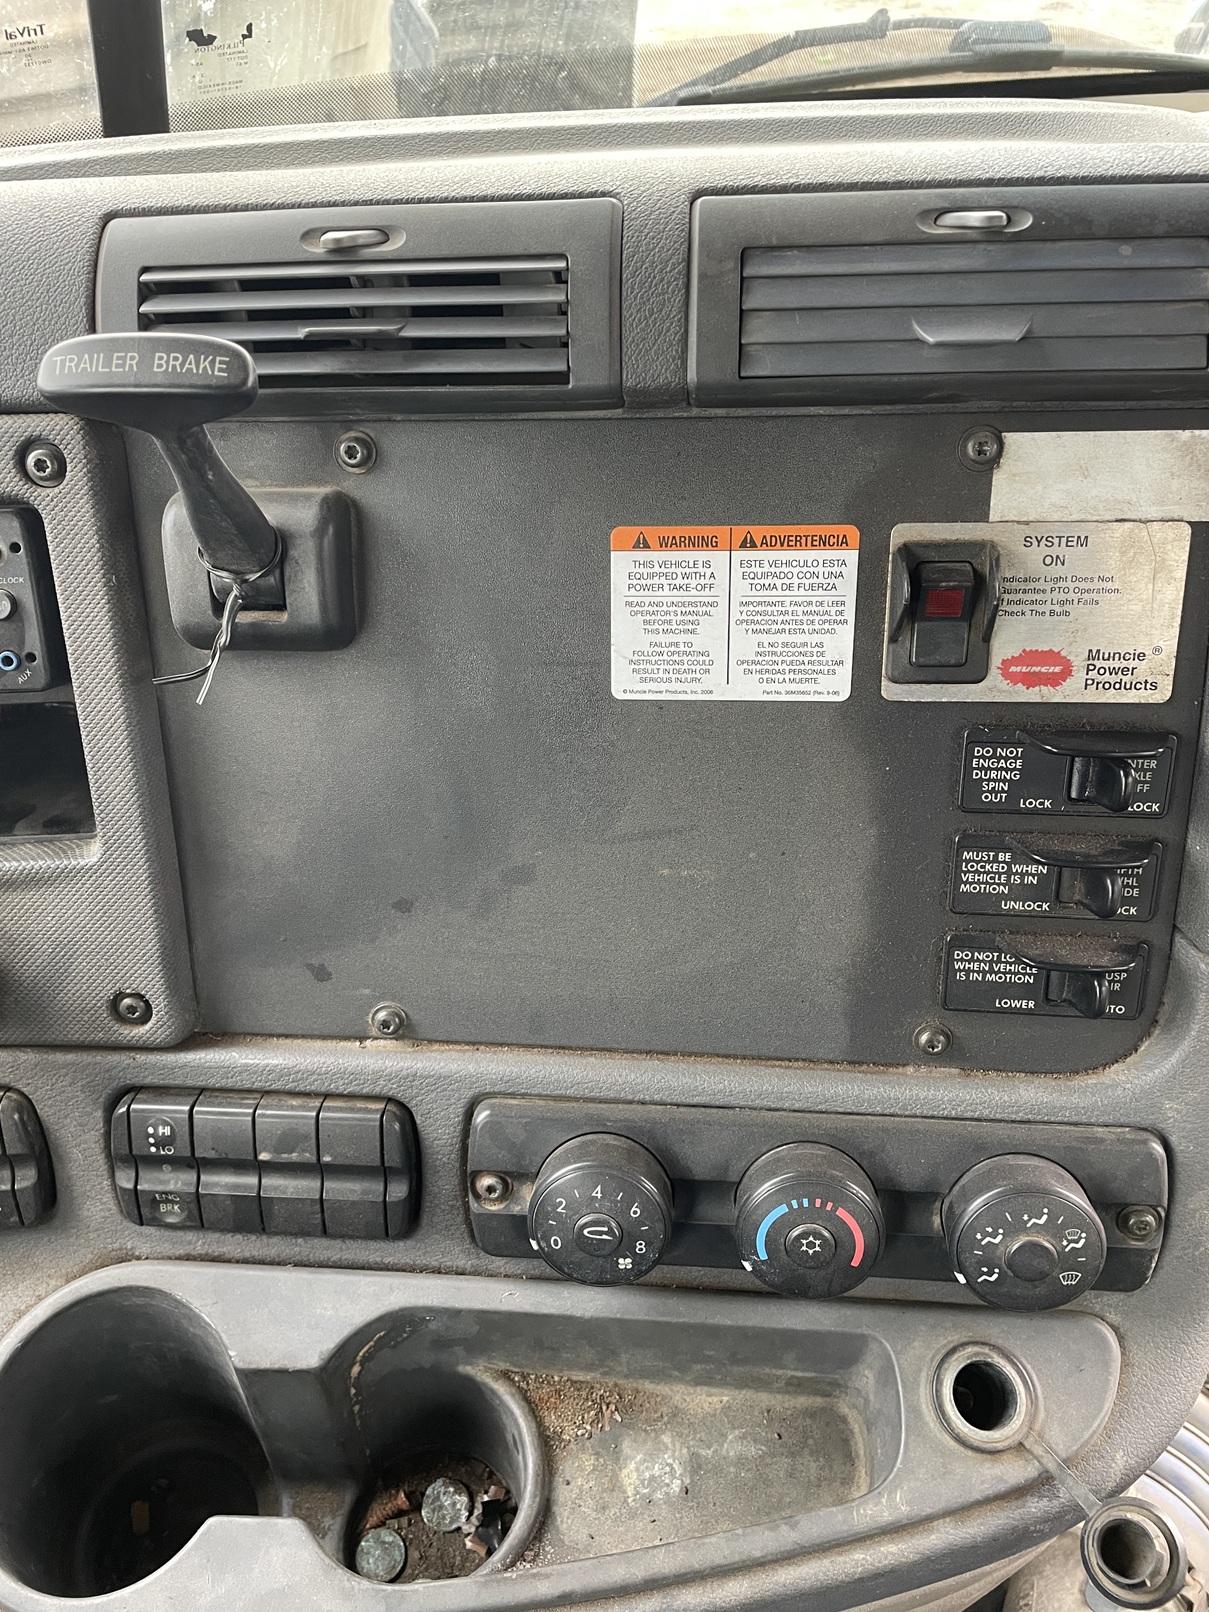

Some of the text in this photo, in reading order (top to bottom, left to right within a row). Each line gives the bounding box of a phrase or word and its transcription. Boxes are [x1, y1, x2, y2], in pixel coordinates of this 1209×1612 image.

[52, 352, 229, 376] TRAILER BRAKE
[658, 536, 718, 548] WARNING
[760, 534, 849, 547] ADVERTENCIA
[1023, 536, 1089, 547] SYSTEM
[632, 560, 711, 568] THIS VEHICLE IS
[740, 559, 847, 568] ESTE VEHICULO ESTA
[1043, 555, 1066, 566] ON
[628, 572, 716, 580] EQUIPPED WITH A
[742, 571, 844, 580] EQUIPADO CON UNA
[1001, 575, 1114, 584] ndicator Light Does Not
[628, 583, 715, 592] POWER TAKE-OFF
[749, 583, 837, 591] TOMA DE FUERZA
[1073, 587, 1122, 595] Operation.
[1051, 598, 1074, 607] Light
[998, 609, 1070, 617] Check The Bulb
[1087, 649, 1146, 662] Muncie
[1009, 665, 1063, 673] MUNCIE
[1086, 664, 1137, 676] Power
[18, 668, 32, 684] AUX
[1084, 678, 1158, 691] Products
[974, 748, 1024, 757] DO NOT
[972, 759, 1023, 769] ENGAGE
[1128, 760, 1157, 768] NTER
[972, 770, 1020, 780] DURING
[1134, 772, 1152, 780] XLE
[982, 781, 1008, 791] SPIN
[1137, 784, 1150, 792] FF
[982, 793, 1007, 802] OUT
[1020, 798, 1052, 808] LOCK
[962, 851, 1012, 861] MUST BE
[962, 862, 1047, 874] LOCKED WHEN
[961, 873, 1037, 884] VEHICLE IS IN
[1122, 877, 1138, 886] HL
[960, 884, 1009, 894] MOTION
[1001, 900, 1050, 911] UNLOCK
[954, 951, 971, 959] DO
[974, 952, 999, 961] NOT
[954, 961, 1038, 973] WHEN VEHICLE
[957, 972, 966, 980] IS
[986, 973, 1034, 984] MOTION
[1111, 982, 1121, 991] IR
[996, 999, 1035, 1008] LOWER
[159, 1126, 170, 1136] HI
[160, 1146, 174, 1154] LO
[592, 1185, 602, 1199] 4
[160, 1203, 181, 1212] BRK
[556, 1198, 566, 1212] 2
[630, 1202, 640, 1217] 6
[551, 1236, 561, 1249] 0
[636, 1241, 646, 1253] 8
